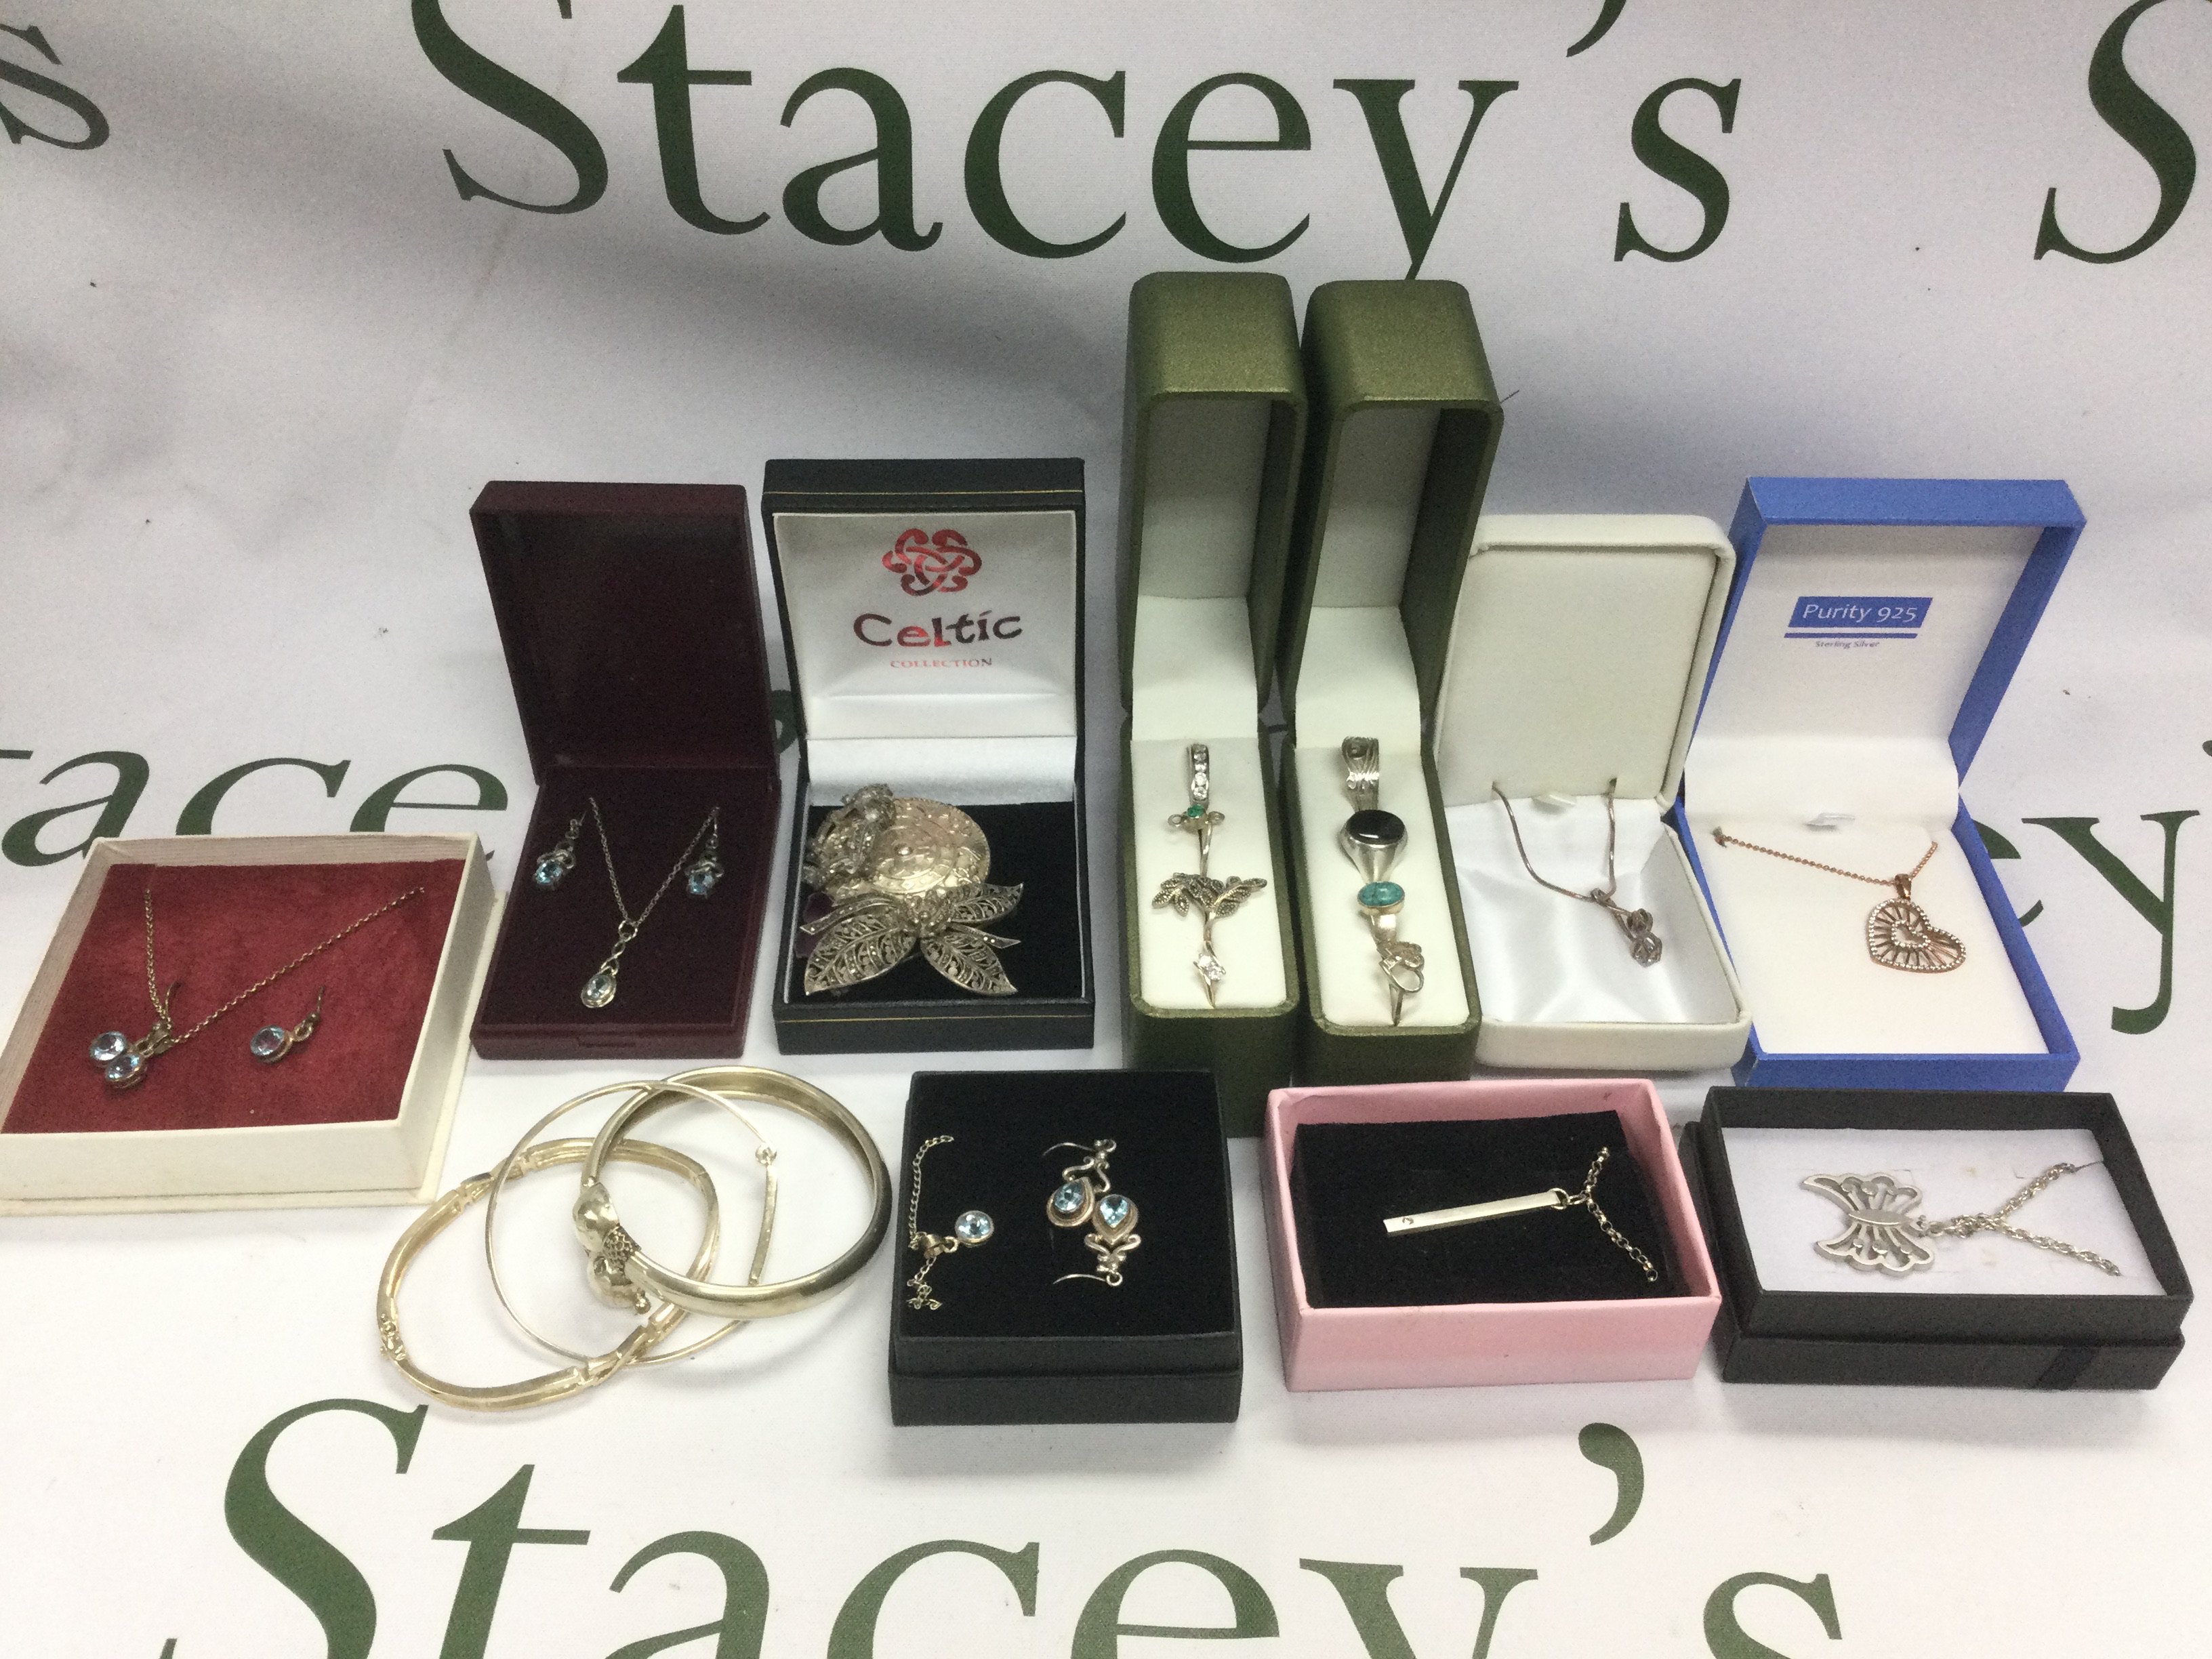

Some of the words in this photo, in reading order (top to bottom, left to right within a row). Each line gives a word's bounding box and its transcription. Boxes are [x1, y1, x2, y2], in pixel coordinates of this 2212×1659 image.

[1802, 603, 1872, 623] Purity
[1876, 607, 1918, 623] 925
[1816, 640, 1852, 650] Sterling
[889, 657, 993, 669] COLLECTION
